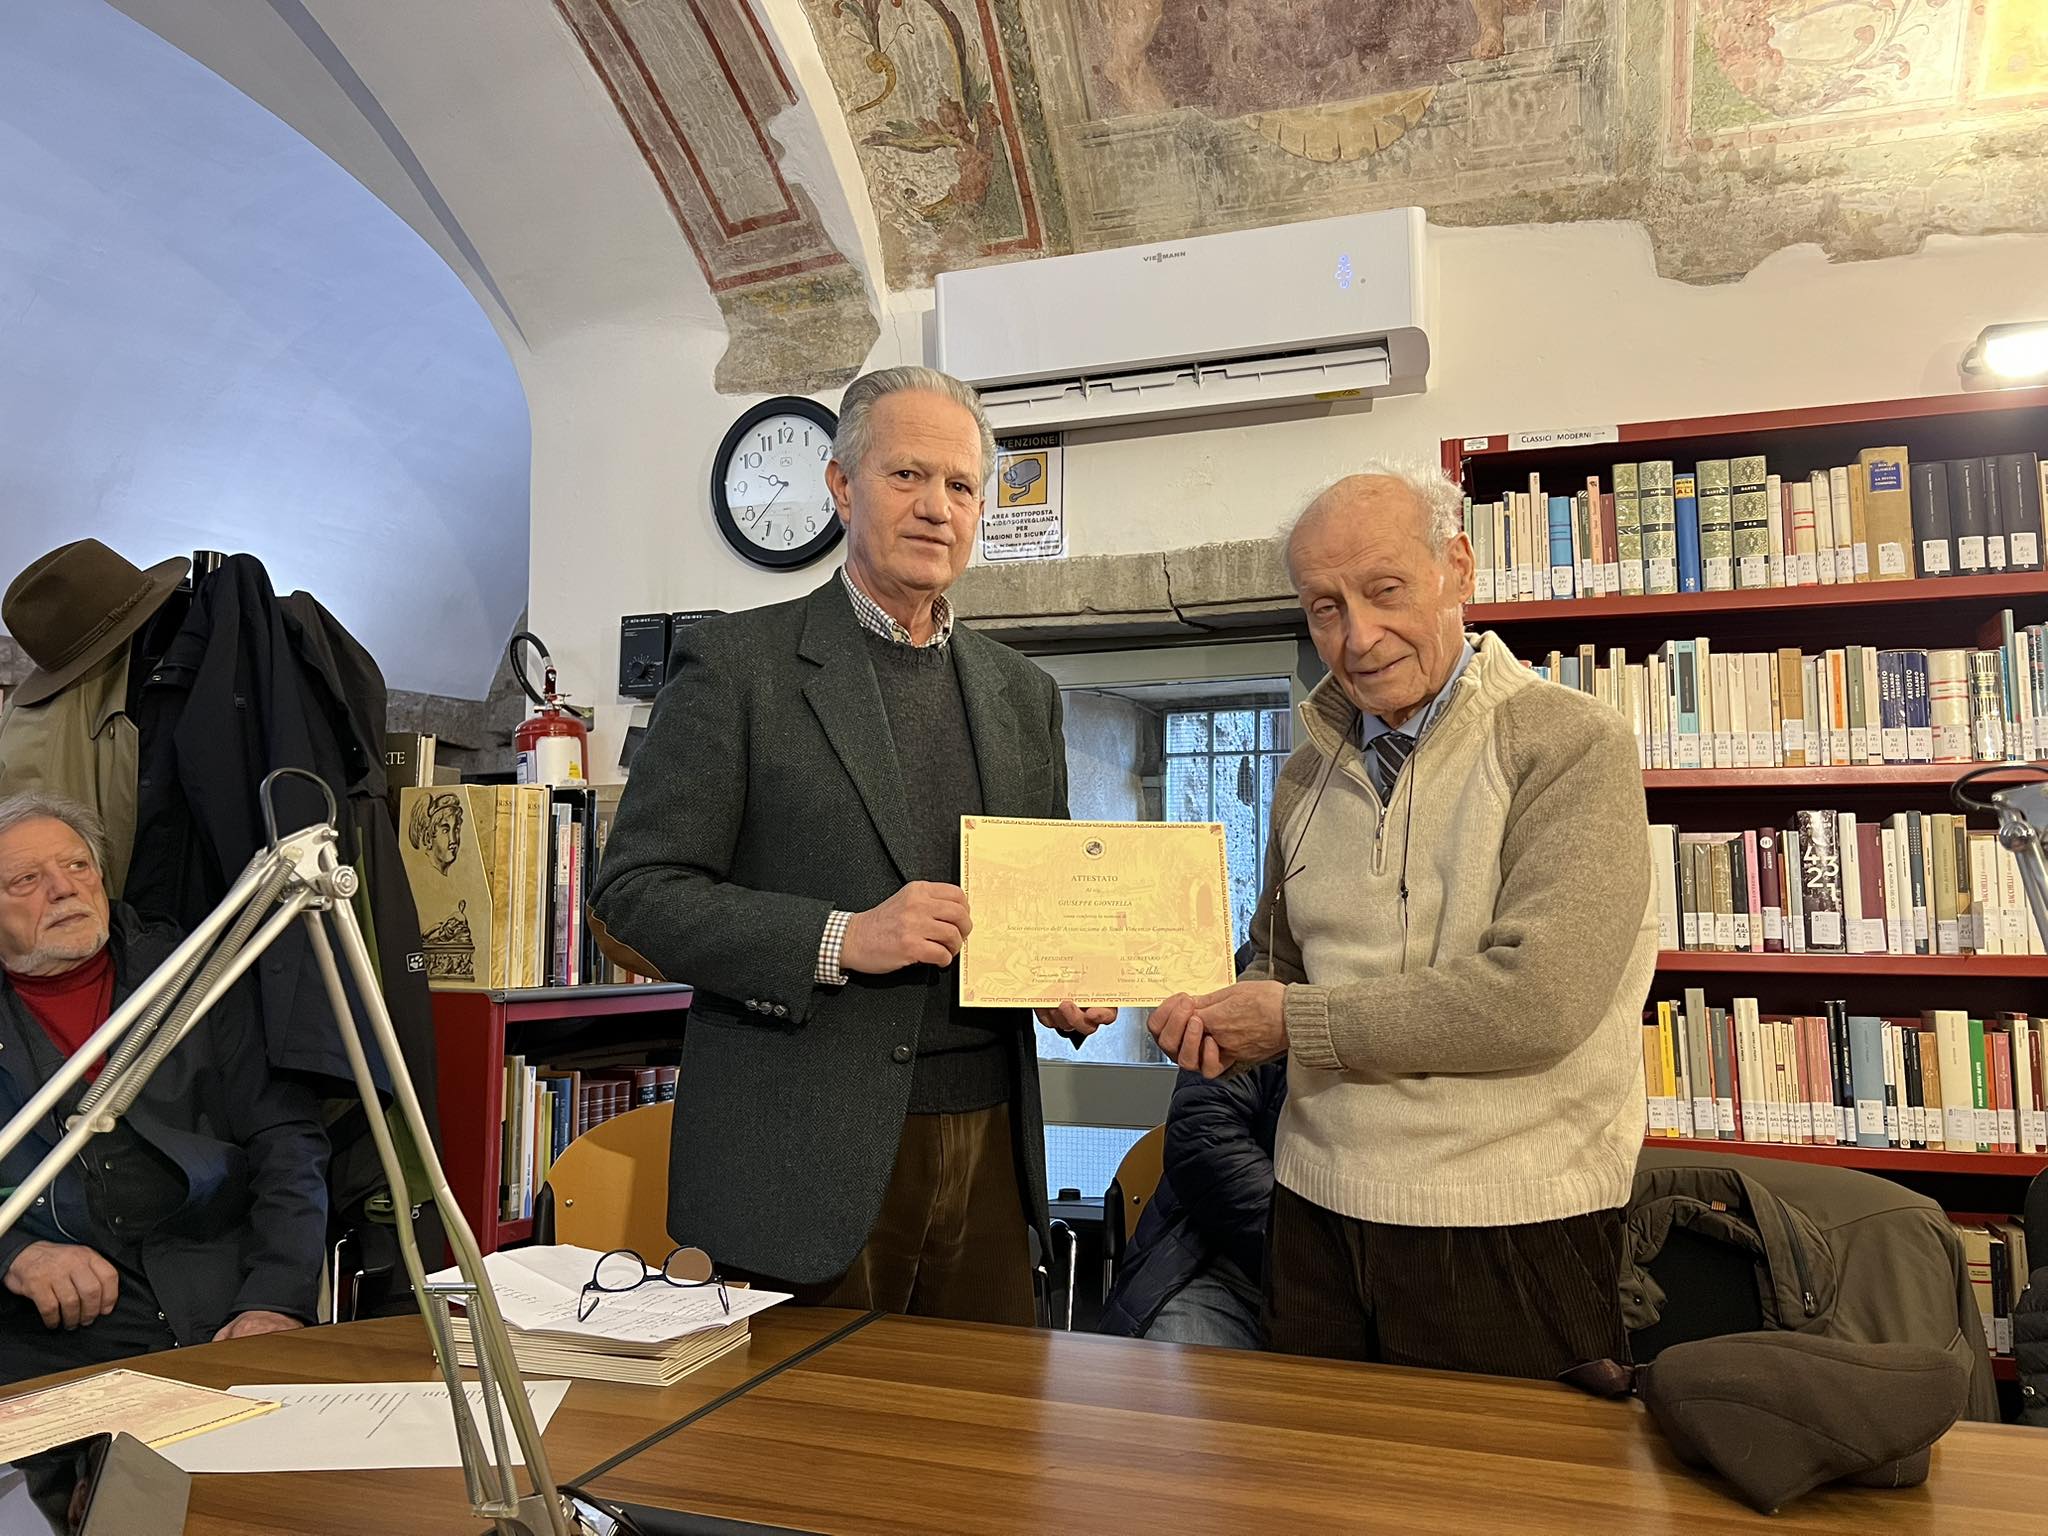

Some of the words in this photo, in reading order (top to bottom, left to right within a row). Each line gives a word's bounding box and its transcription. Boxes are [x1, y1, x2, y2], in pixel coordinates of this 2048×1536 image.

[761, 435, 773, 452] 11
[778, 427, 794, 444] 12
[804, 430, 809, 447] 1
[1521, 435, 1552, 444] CLASSICI
[1557, 432, 1592, 441] MODERNI
[743, 452, 763, 469] 10
[817, 445, 828, 461] 2
[737, 481, 748, 496] 9
[745, 506, 755, 521] 8
[821, 497, 830, 513] 4
[1011, 509, 1053, 518] SOTTOPOSTA
[764, 520, 772, 537] 7
[805, 516, 816, 532] 5
[783, 525, 794, 542] 6
[1906, 669, 1914, 700] ARIOSTO
[1803, 845, 1820, 865] 4
[1824, 856, 1839, 877] 3
[1806, 867, 1824, 888] 2
[1827, 882, 1837, 901] 1
